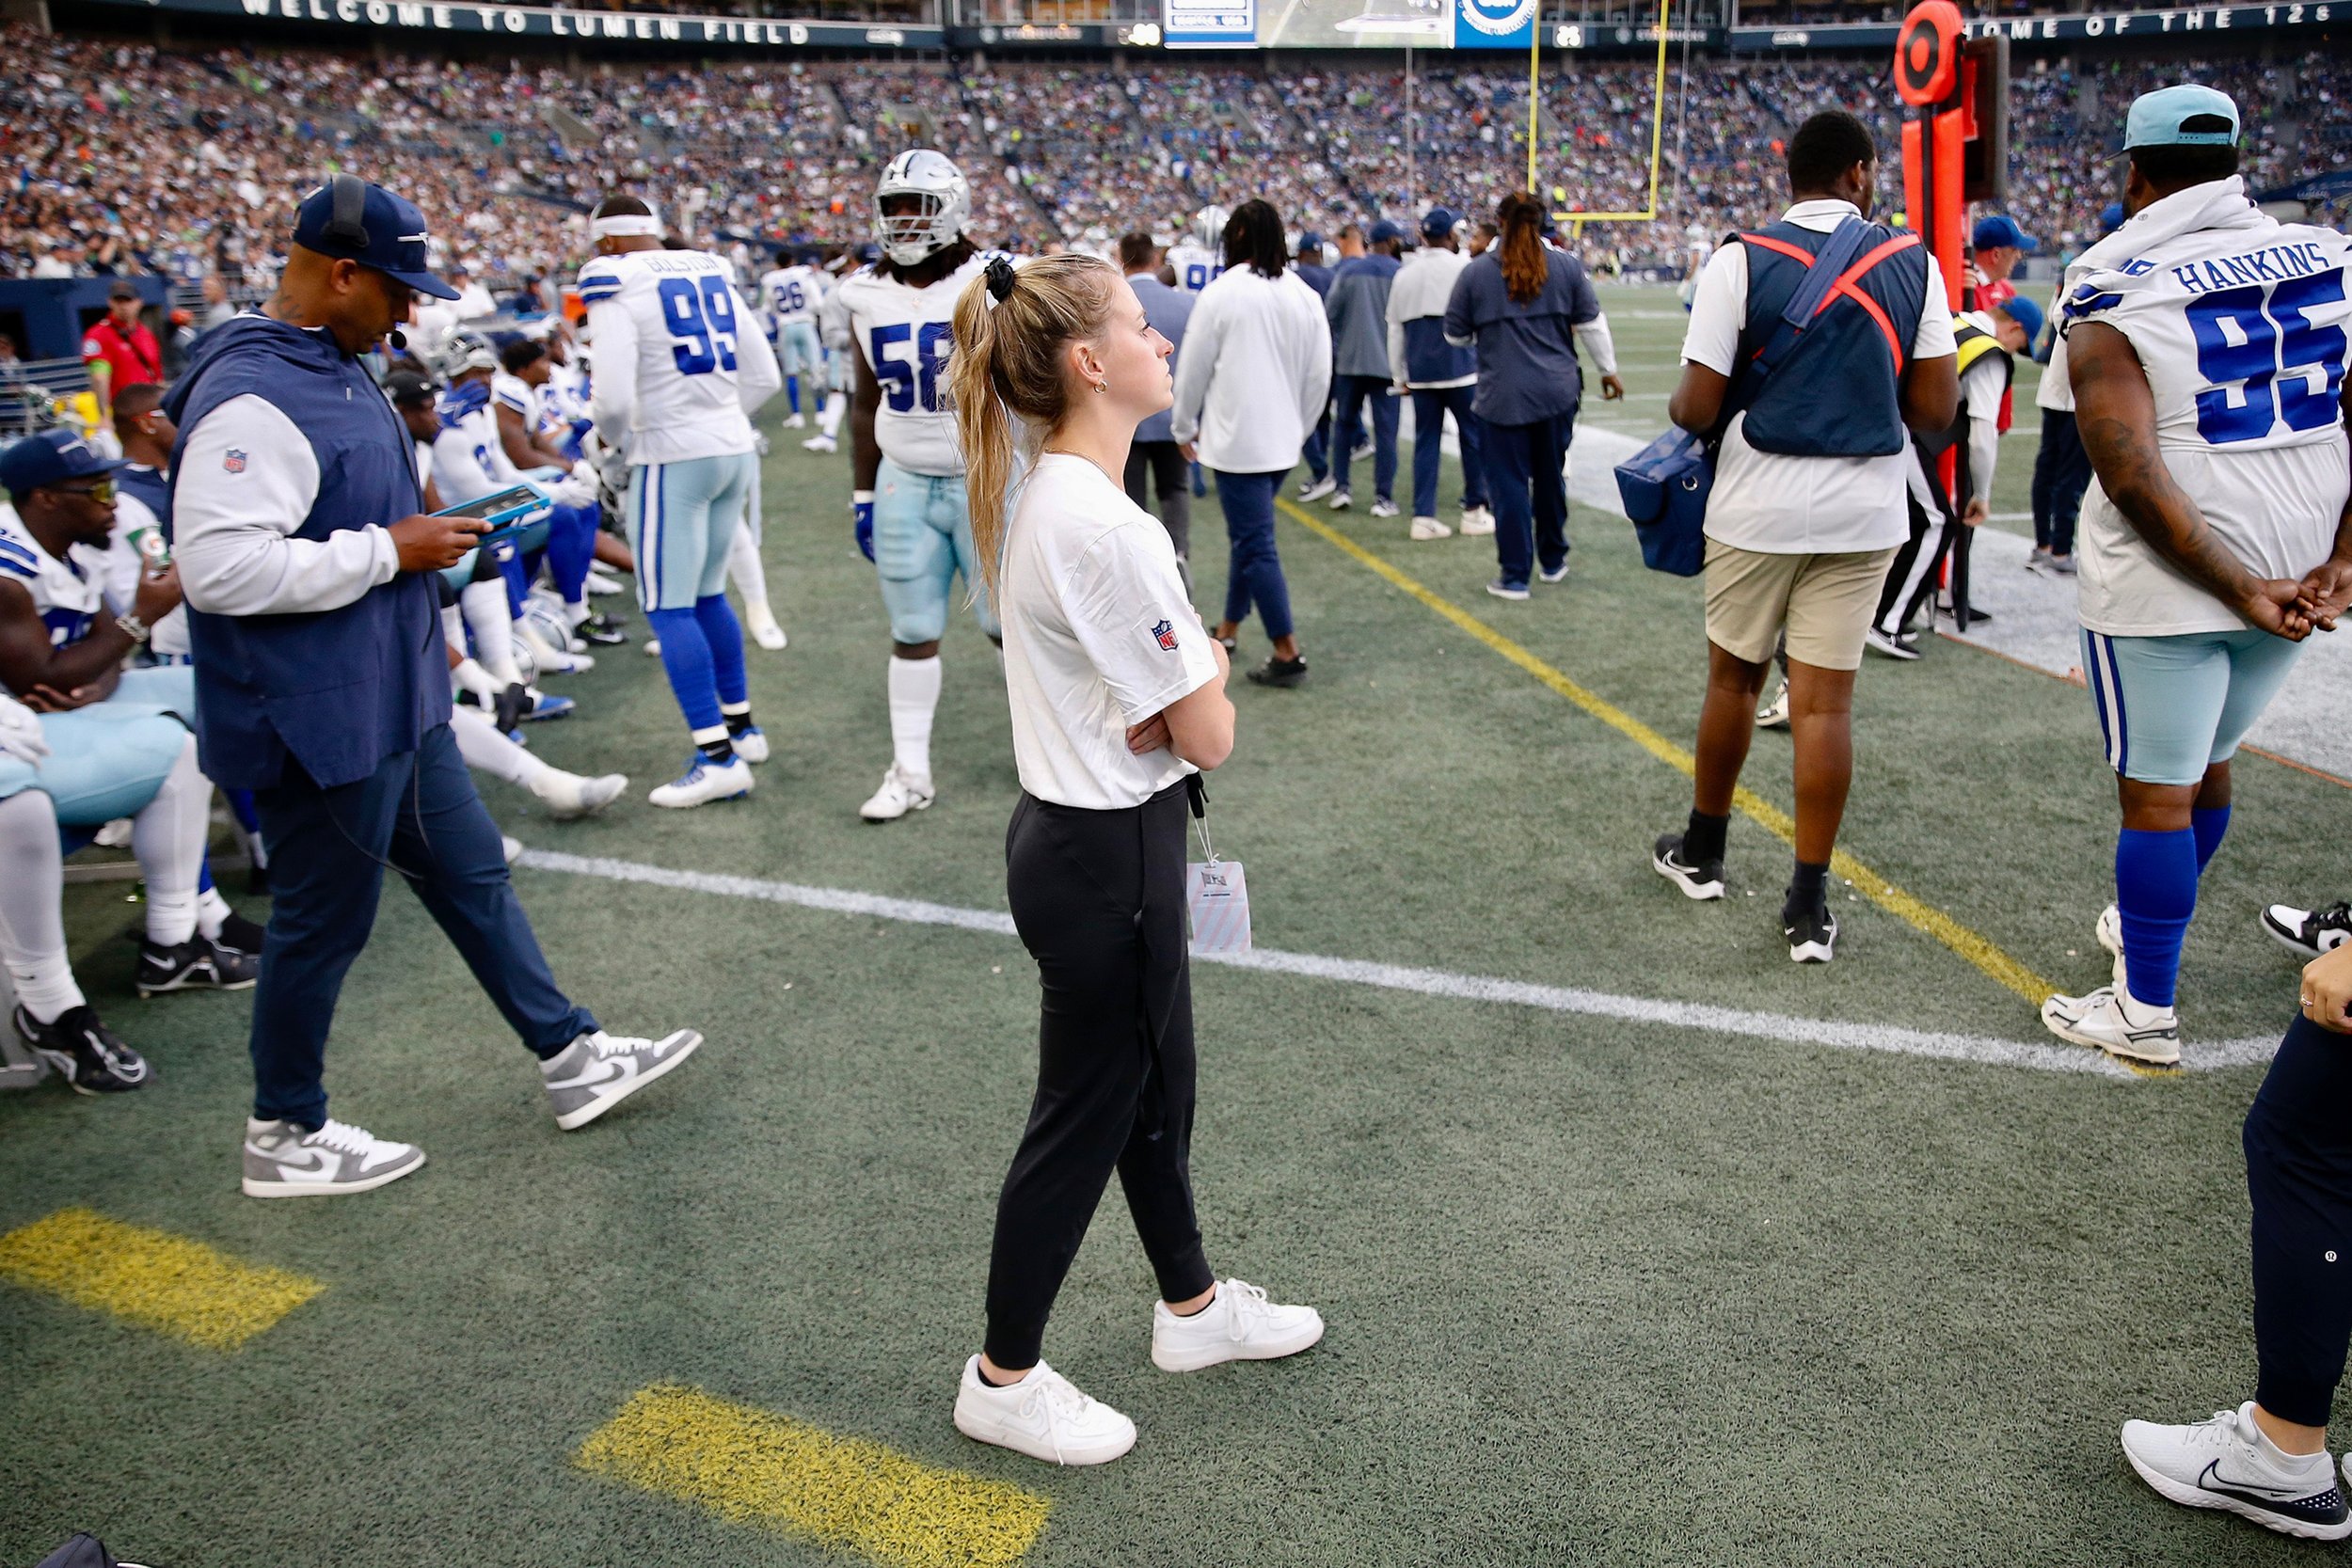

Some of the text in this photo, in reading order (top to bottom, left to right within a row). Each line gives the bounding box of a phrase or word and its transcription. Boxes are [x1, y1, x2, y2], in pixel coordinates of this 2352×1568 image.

[243, 0, 809, 44] WELCOME TO LUMEN FIELD
[2085, 14, 2132, 36] OF
[2160, 8, 2233, 32] THE
[2171, 243, 2329, 293] HANKINS
[773, 281, 804, 313] 26
[659, 275, 738, 375] 99
[2184, 266, 2347, 445] 95
